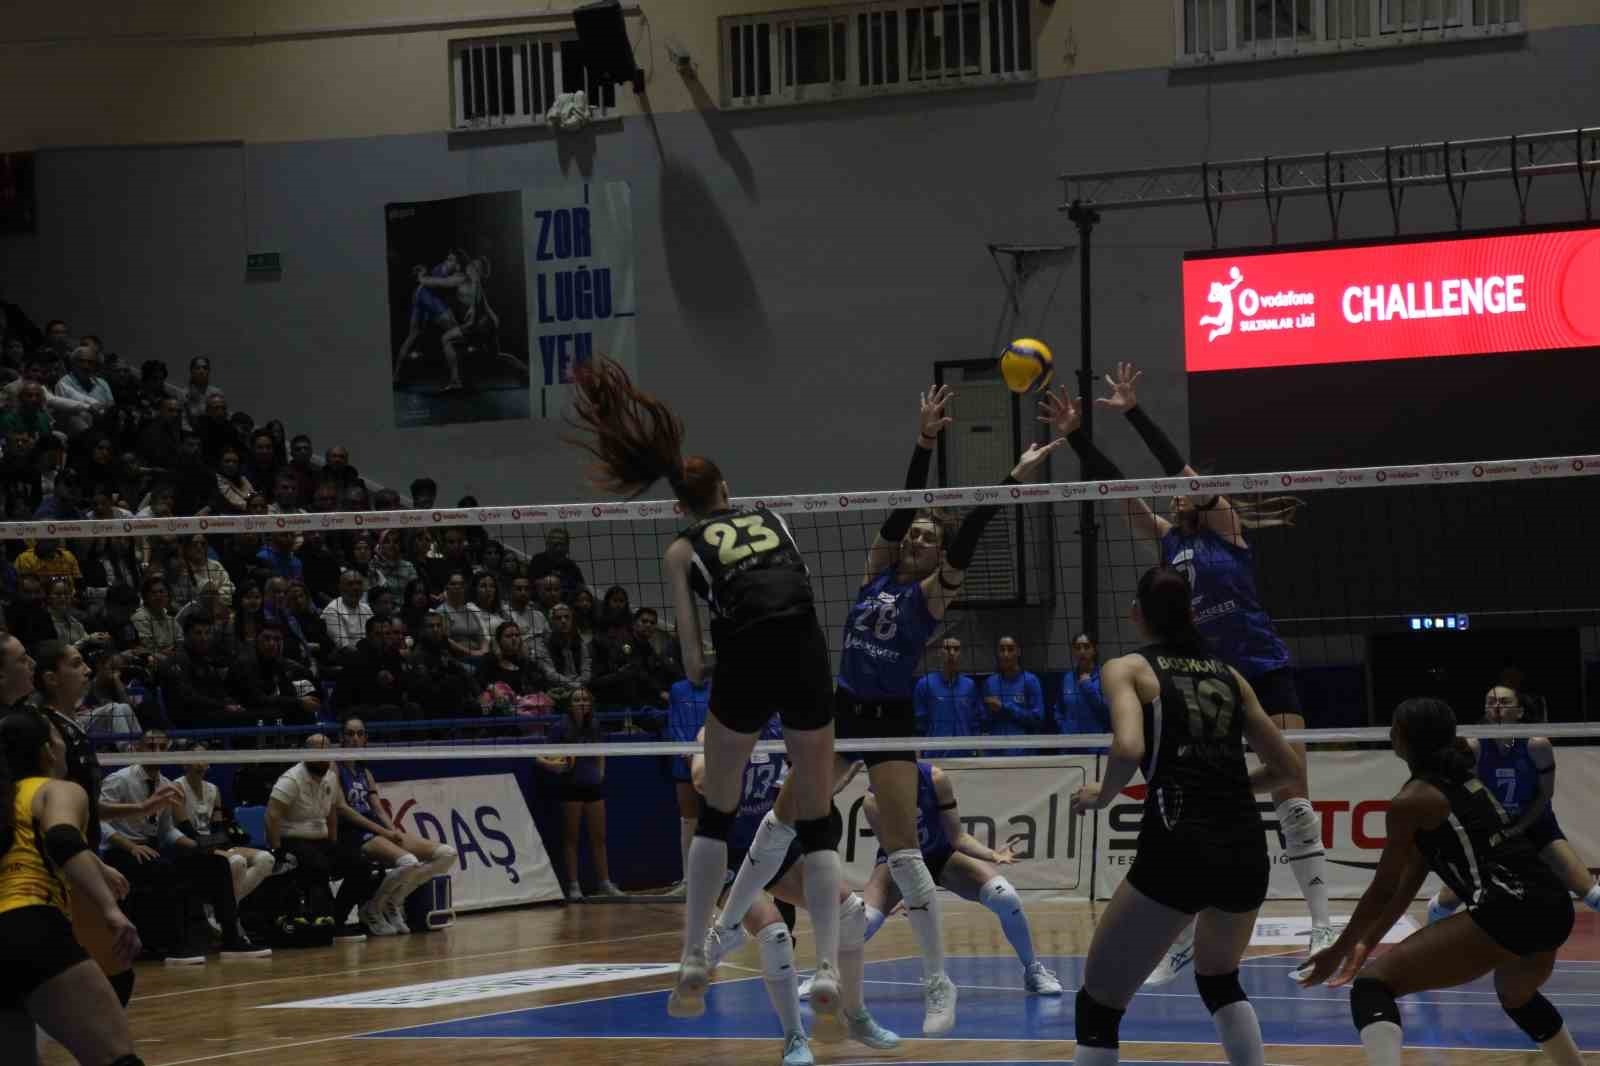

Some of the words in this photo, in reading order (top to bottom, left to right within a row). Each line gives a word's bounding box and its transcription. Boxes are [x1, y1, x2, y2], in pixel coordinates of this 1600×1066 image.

[535, 207, 591, 261] ZOR
[538, 265, 612, 322] LUĞU
[1260, 290, 1315, 308] vodafone
[1342, 274, 1526, 323] CHALLENGE
[1240, 317, 1294, 332] SULTANLAR
[703, 514, 780, 566] 23
[1172, 677, 1234, 736] 19
[745, 764, 776, 799] 13
[1496, 778, 1517, 802] 7
